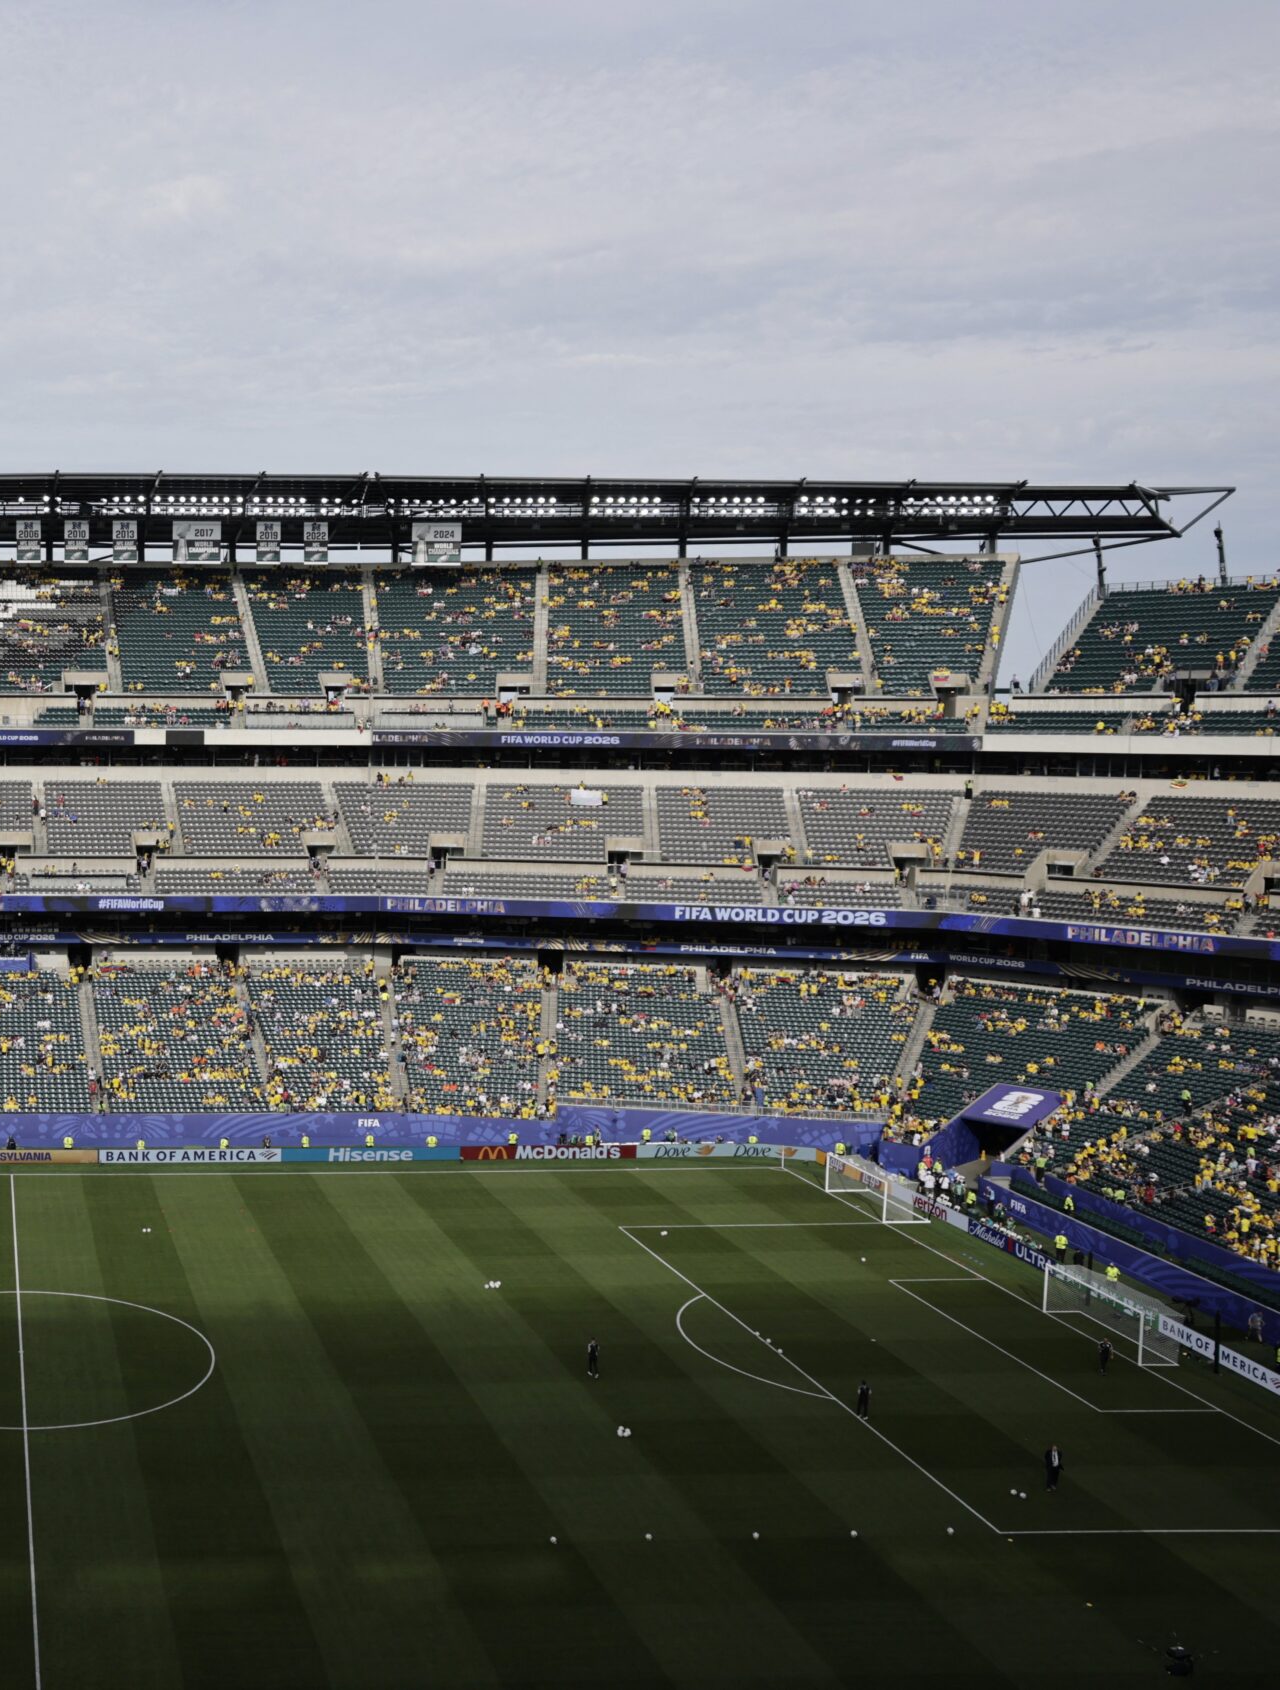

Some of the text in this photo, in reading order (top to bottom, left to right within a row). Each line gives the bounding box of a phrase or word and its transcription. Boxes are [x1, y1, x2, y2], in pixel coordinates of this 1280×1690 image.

[19, 530, 39, 539] 2006
[67, 530, 87, 539] 2010
[115, 530, 135, 539] 2013
[194, 529, 214, 537] 2017
[259, 531, 278, 540] 2019
[306, 532, 327, 540] 2022
[433, 530, 455, 539] 2024
[501, 735, 620, 745] FIFA WORLD CUP 2026
[98, 898, 165, 911] #FIFAWorldCup
[386, 899, 506, 914] PHILADELPHIA
[674, 906, 887, 926] FIFA WORLD CUP 2026
[186, 933, 274, 941] PHILADELPHIA
[1067, 926, 1215, 952] PHILADELPHIA
[680, 944, 777, 955] PHILADELPHIA
[911, 952, 1026, 969] FIFA WORLD CUP 2026
[358, 1118, 380, 1128] FIFA
[105, 1150, 257, 1162] BANK OF AMERICA
[328, 1148, 413, 1162] Hisense
[515, 1145, 621, 1160] McDonald's
[654, 1146, 692, 1158] Dove
[733, 1145, 771, 1158] Dove
[912, 1194, 947, 1221] verizon
[1010, 1199, 1027, 1215] FIFA
[970, 1221, 1055, 1275] Michelob ULTRA
[1162, 1320, 1268, 1384] BANK OF MERICA
